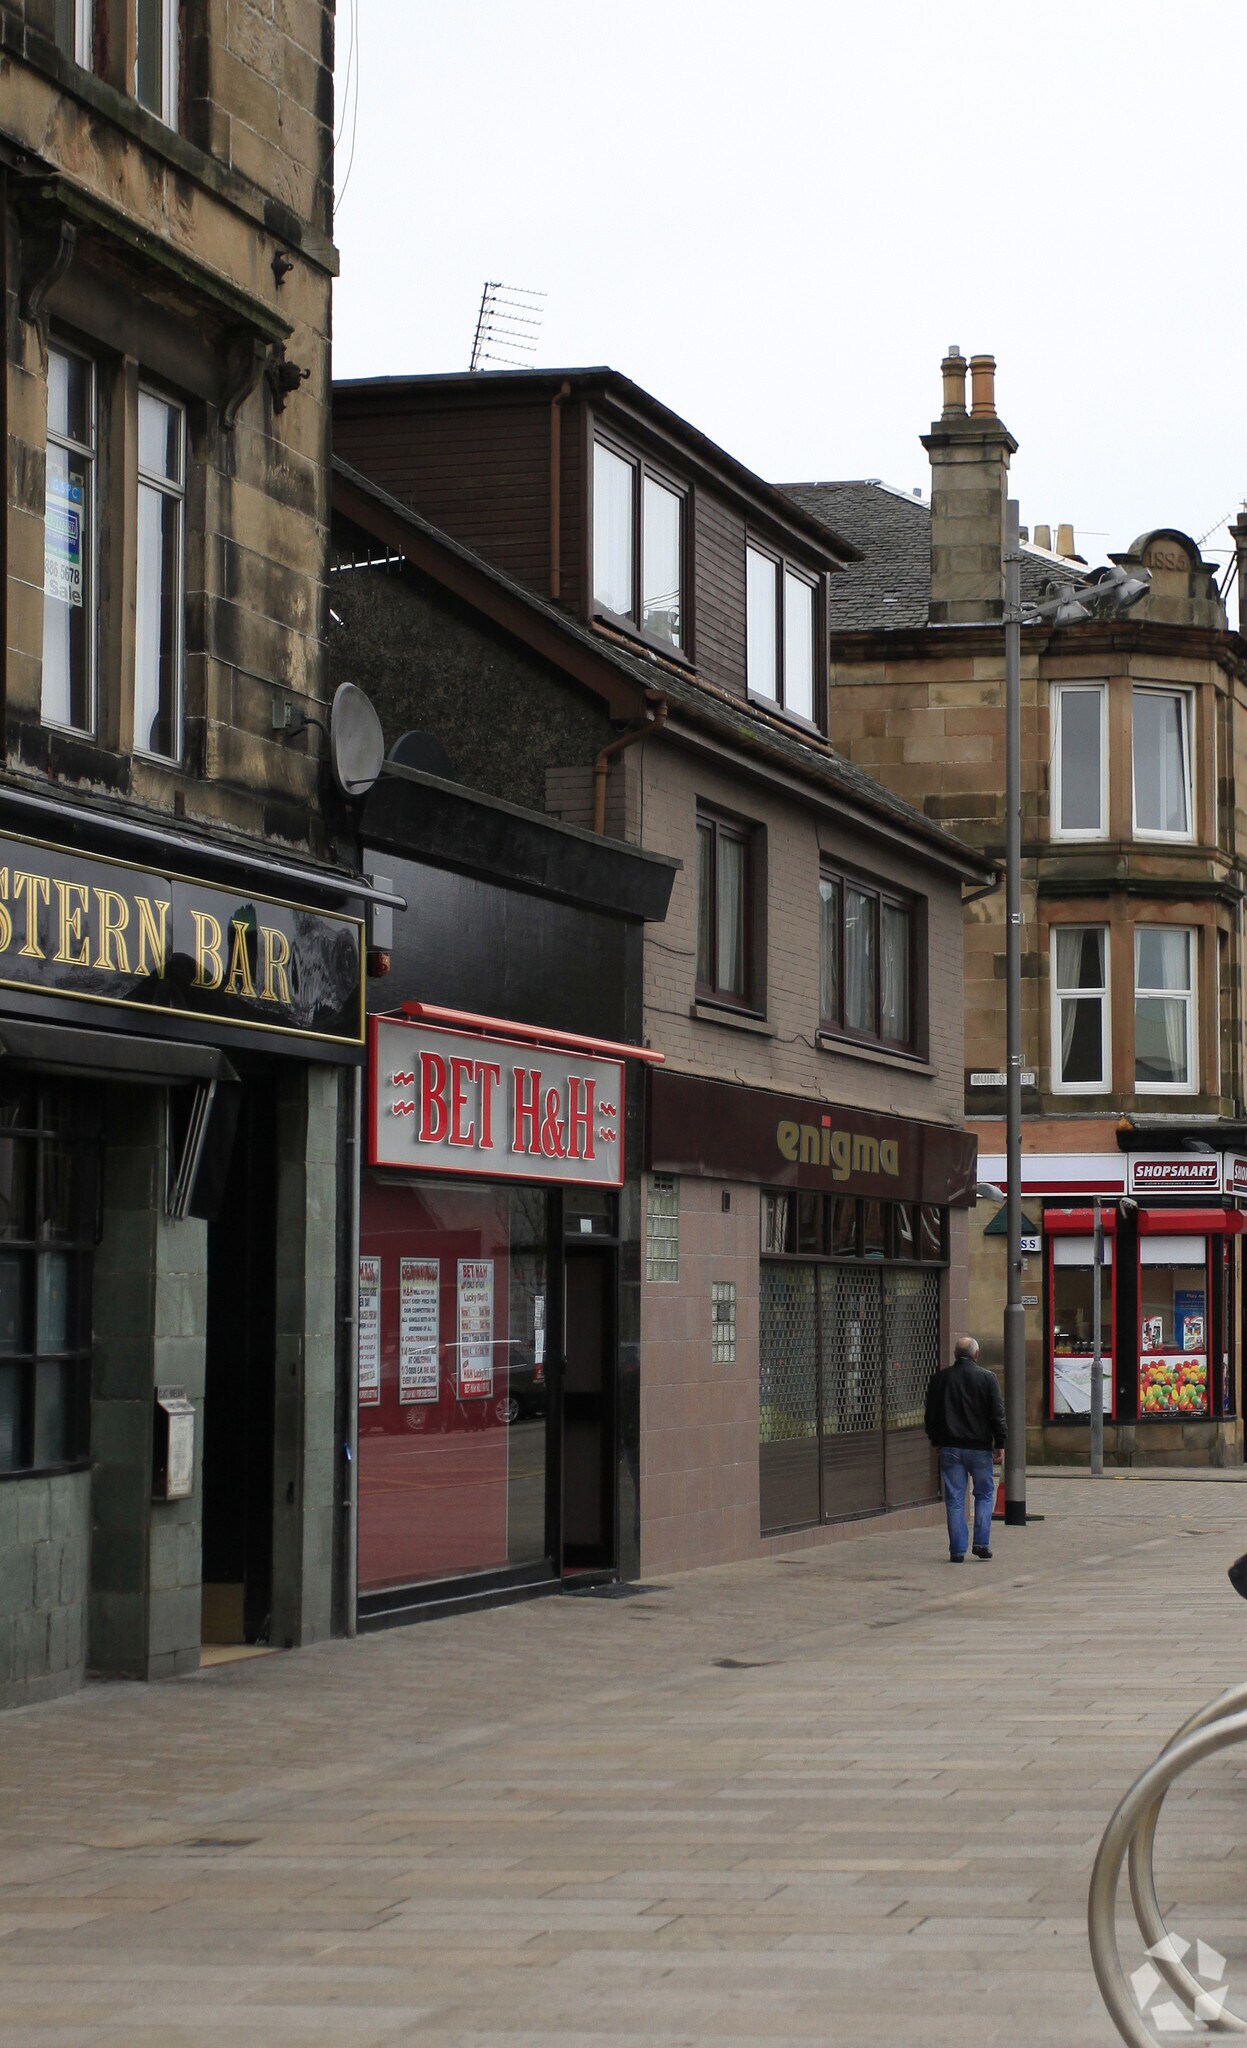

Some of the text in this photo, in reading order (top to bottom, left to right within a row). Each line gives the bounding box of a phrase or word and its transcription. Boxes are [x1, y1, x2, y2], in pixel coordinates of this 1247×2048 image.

[191, 910, 291, 1004] BAR
[973, 1074, 1032, 1084] MUIR SET
[418, 1051, 596, 1160] BET H&H
[776, 1115, 899, 1181] enigma
[1136, 1165, 1216, 1177] SHOPSMART
[1234, 1165, 1247, 1181] SHO
